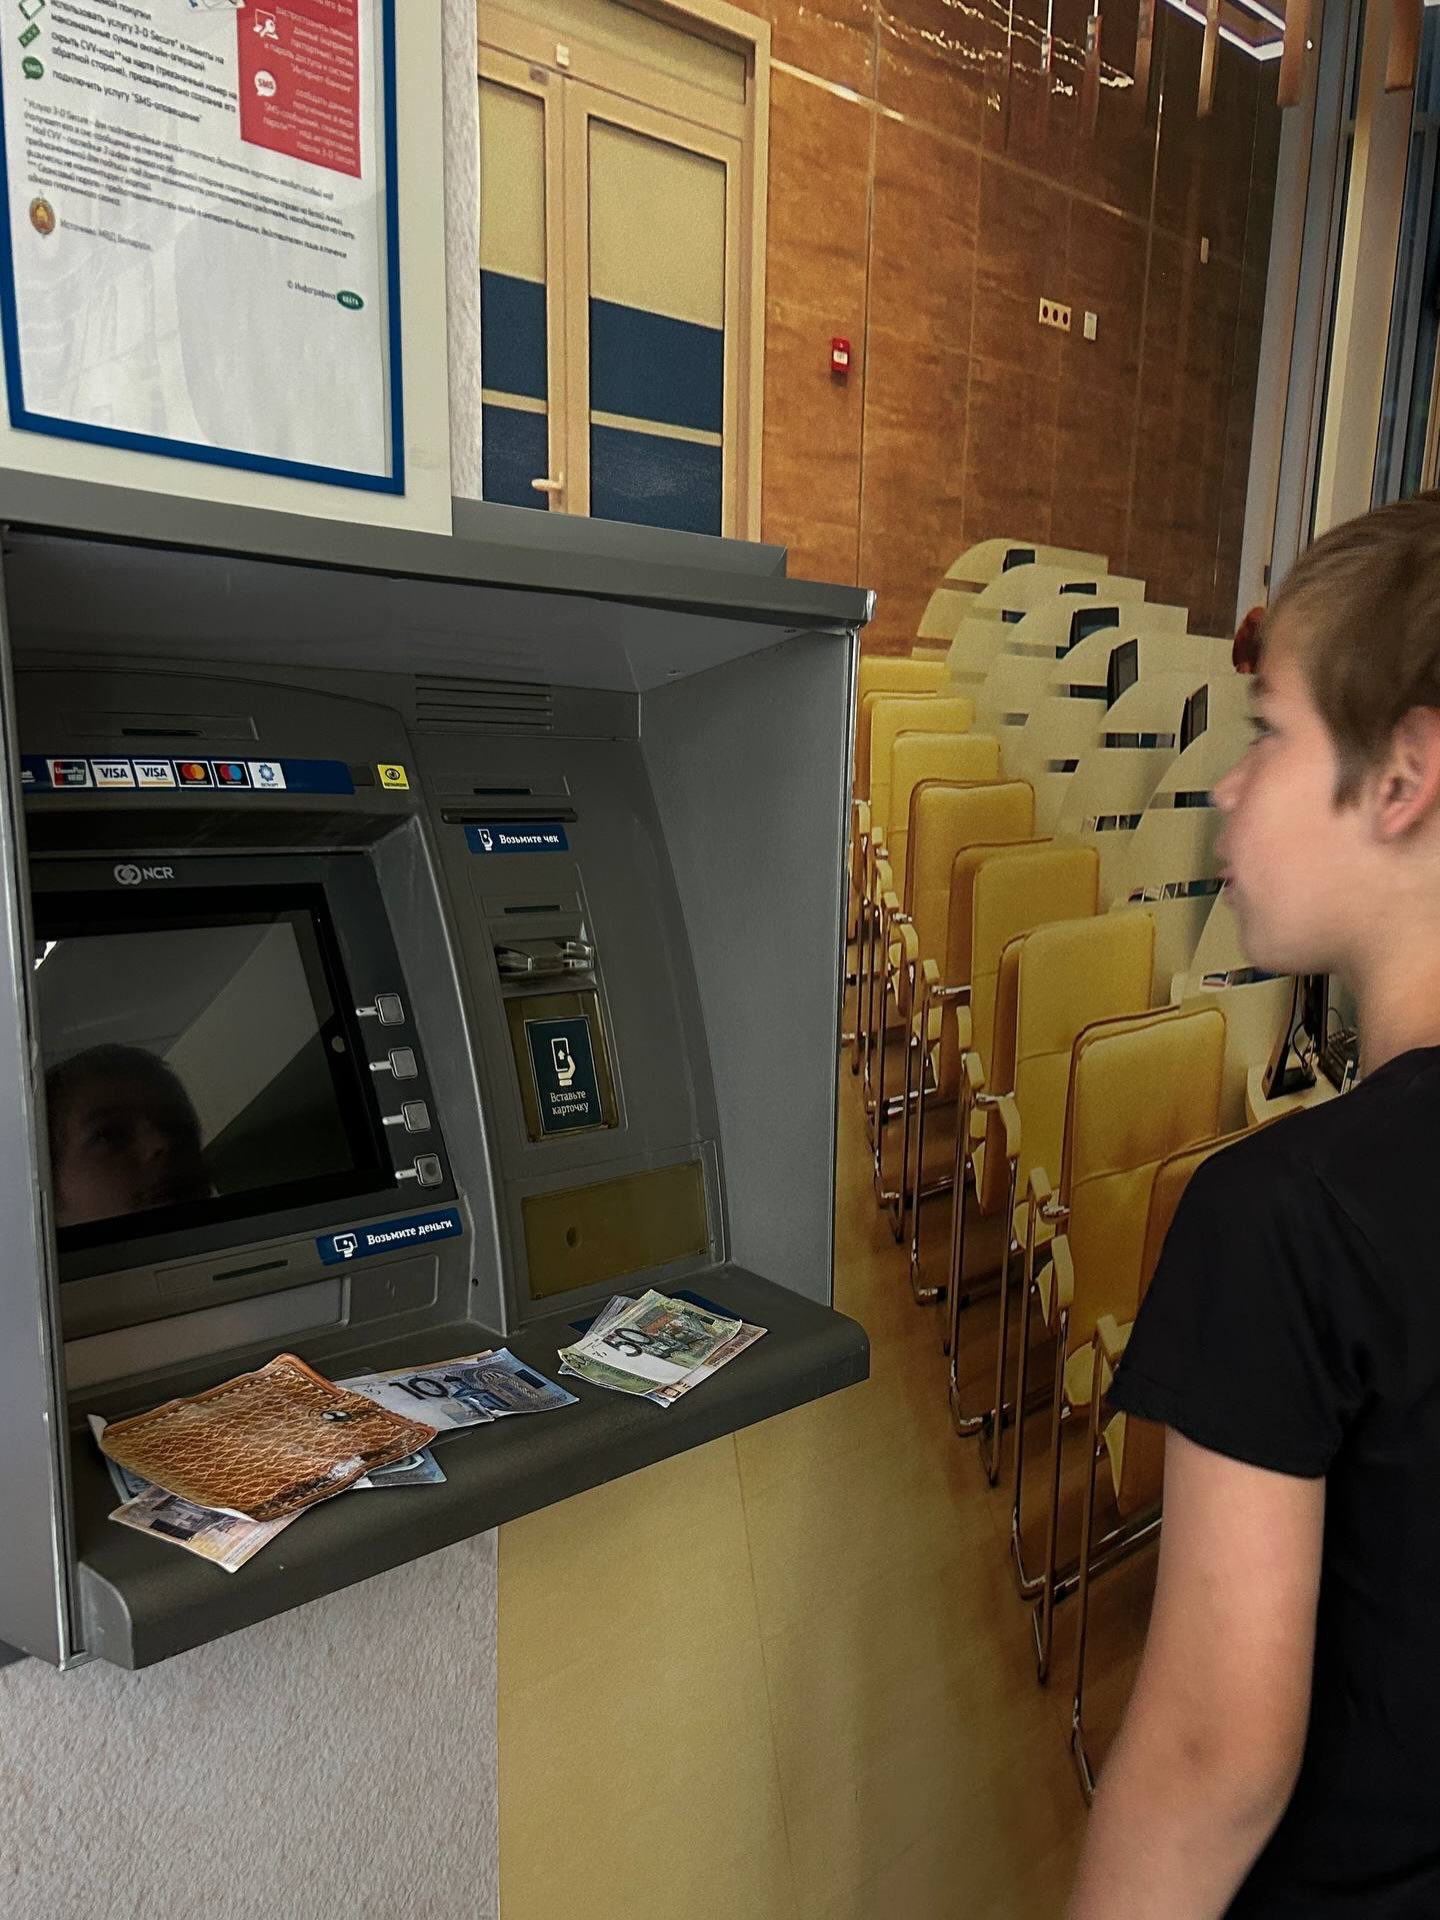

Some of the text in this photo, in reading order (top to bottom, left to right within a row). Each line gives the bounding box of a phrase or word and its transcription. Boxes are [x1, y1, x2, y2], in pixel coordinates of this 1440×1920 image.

[99, 768, 128, 778] VISA
[140, 767, 168, 777] VISA
[499, 834, 559, 844] Возьмите чек
[142, 867, 175, 879] NCR
[550, 1090, 586, 1102] Вставьте
[552, 1102, 589, 1116] карточку
[367, 1219, 453, 1246] Возьмите деньги
[601, 1327, 655, 1357] 50
[389, 1376, 450, 1401] 10
